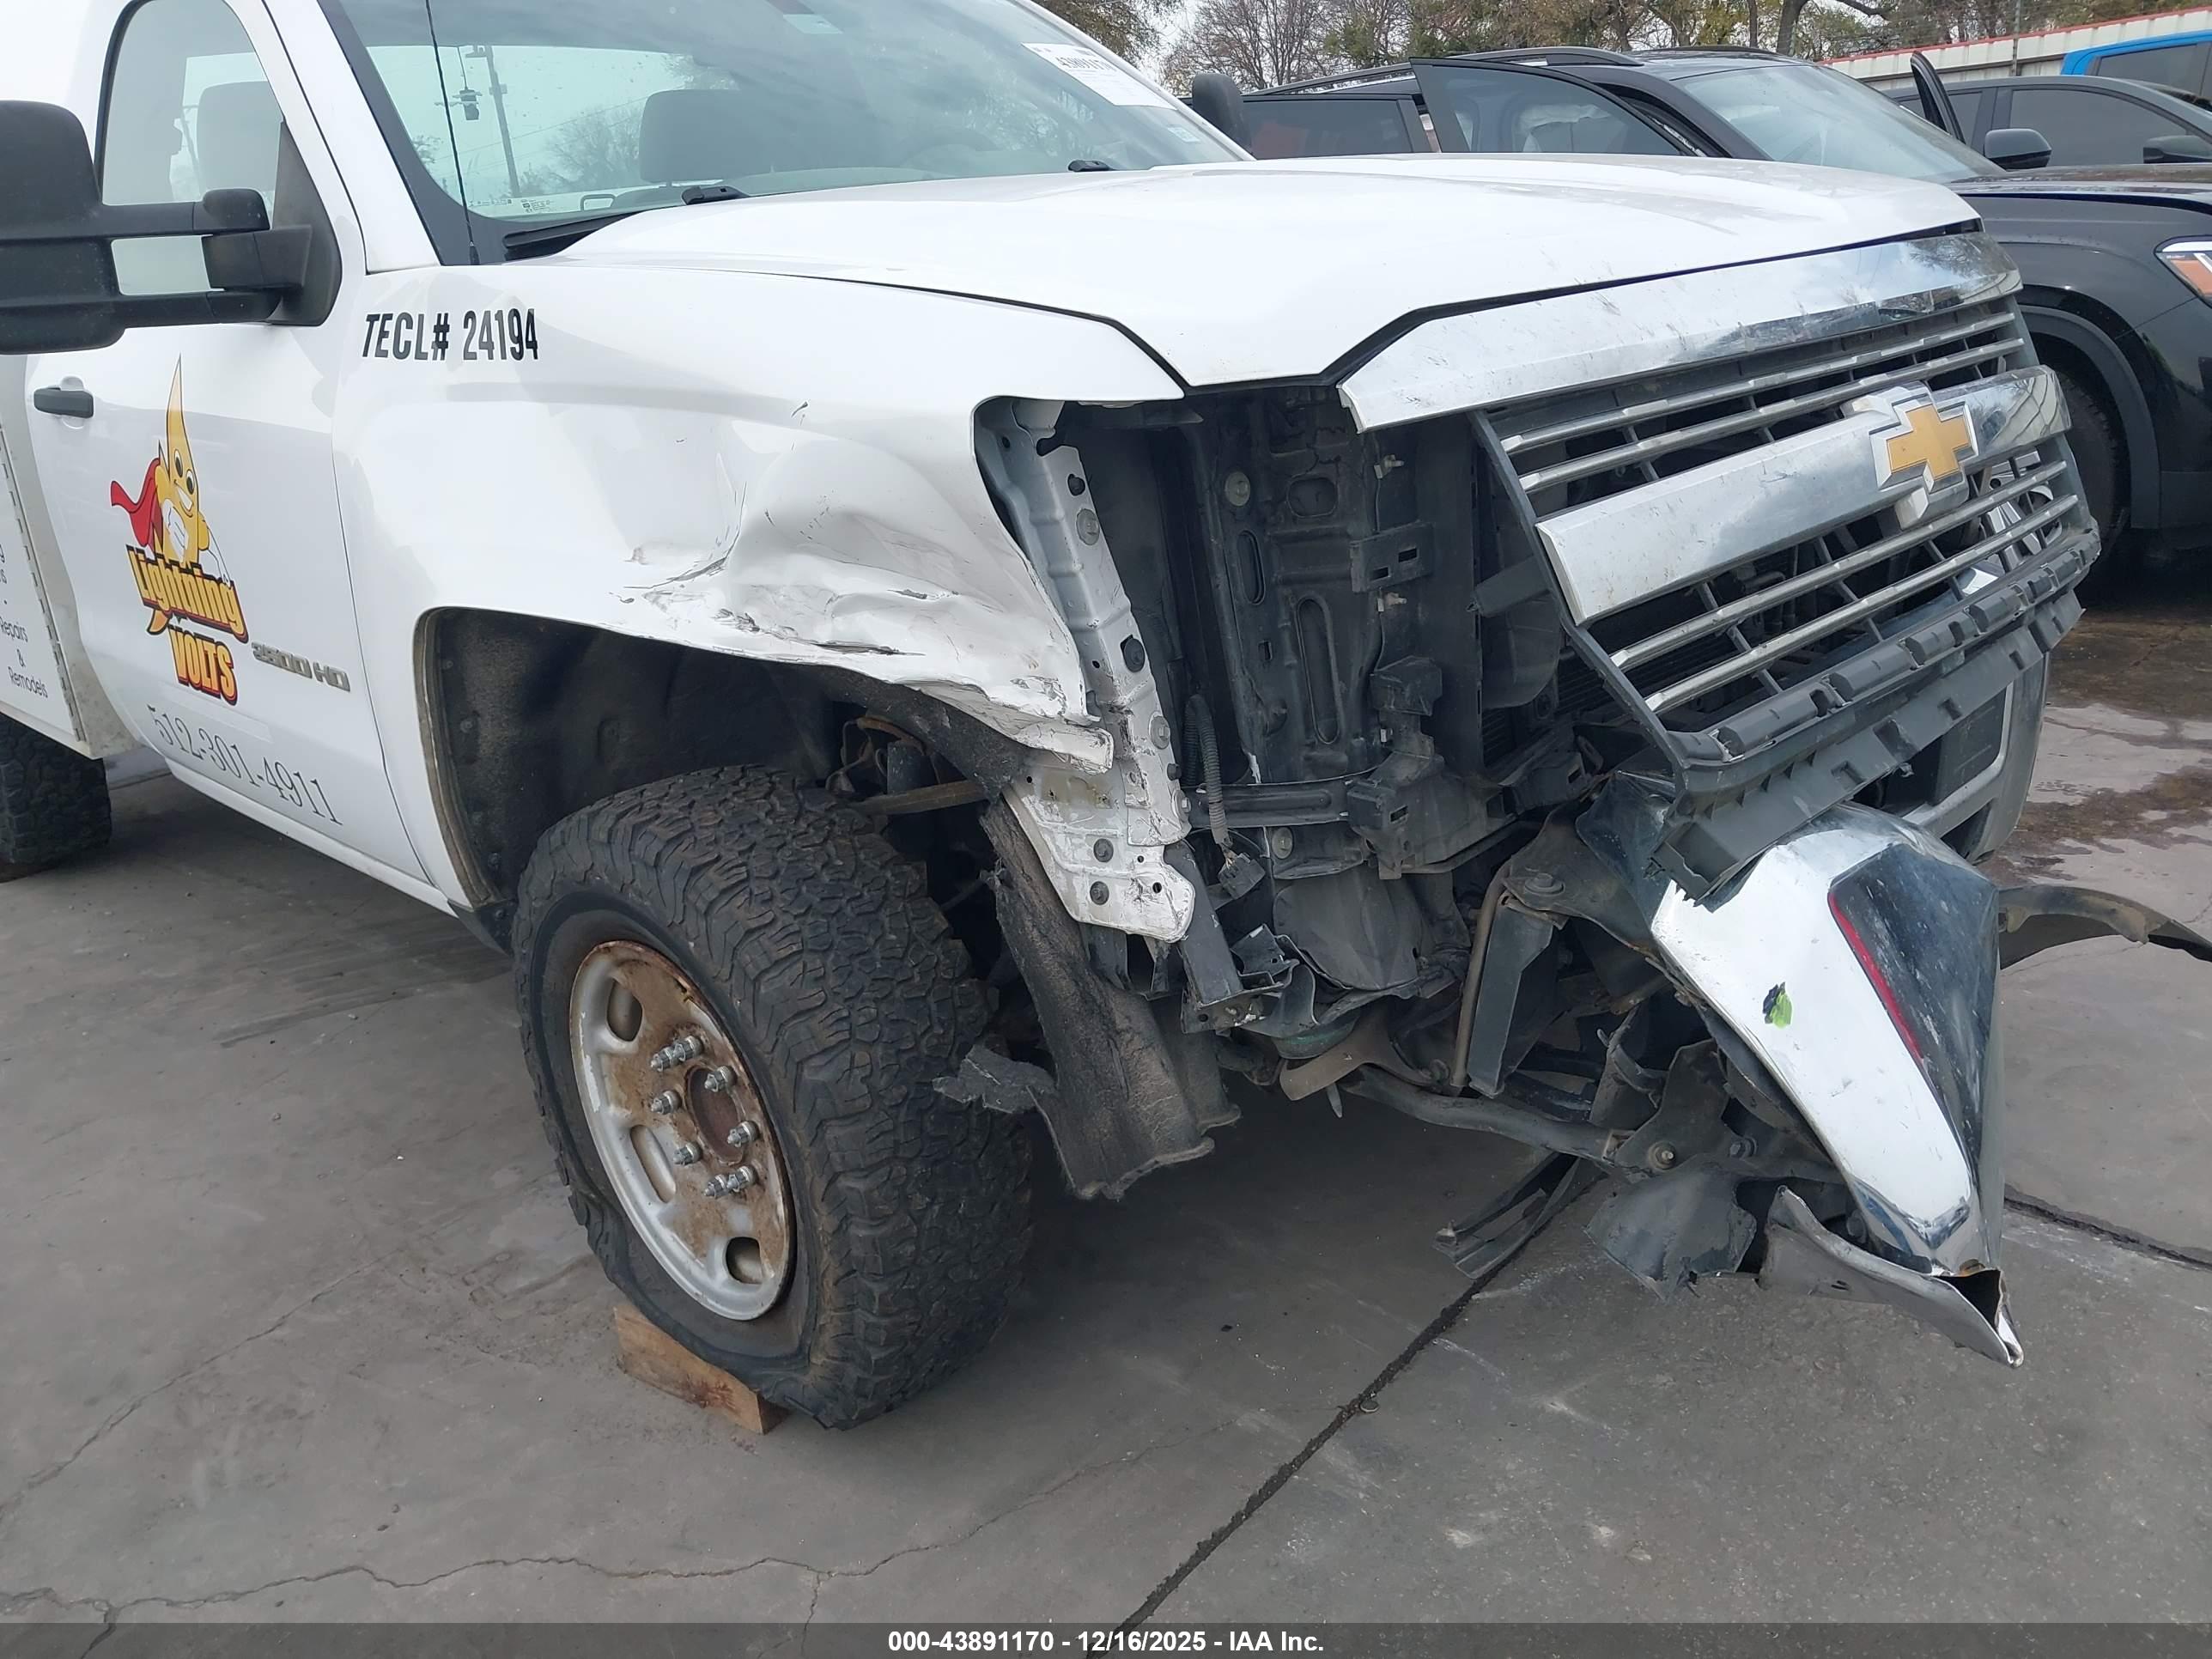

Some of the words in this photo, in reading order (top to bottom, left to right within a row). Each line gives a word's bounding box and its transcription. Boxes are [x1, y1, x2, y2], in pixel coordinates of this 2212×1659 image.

[362, 312, 450, 362] TECL#
[462, 307, 539, 362] 24194
[126, 544, 249, 644] Lightning
[7, 665, 49, 699] Remodels
[16, 648, 27, 667] &
[168, 624, 238, 706] VOLTS
[147, 703, 343, 825] 512-301-4911
